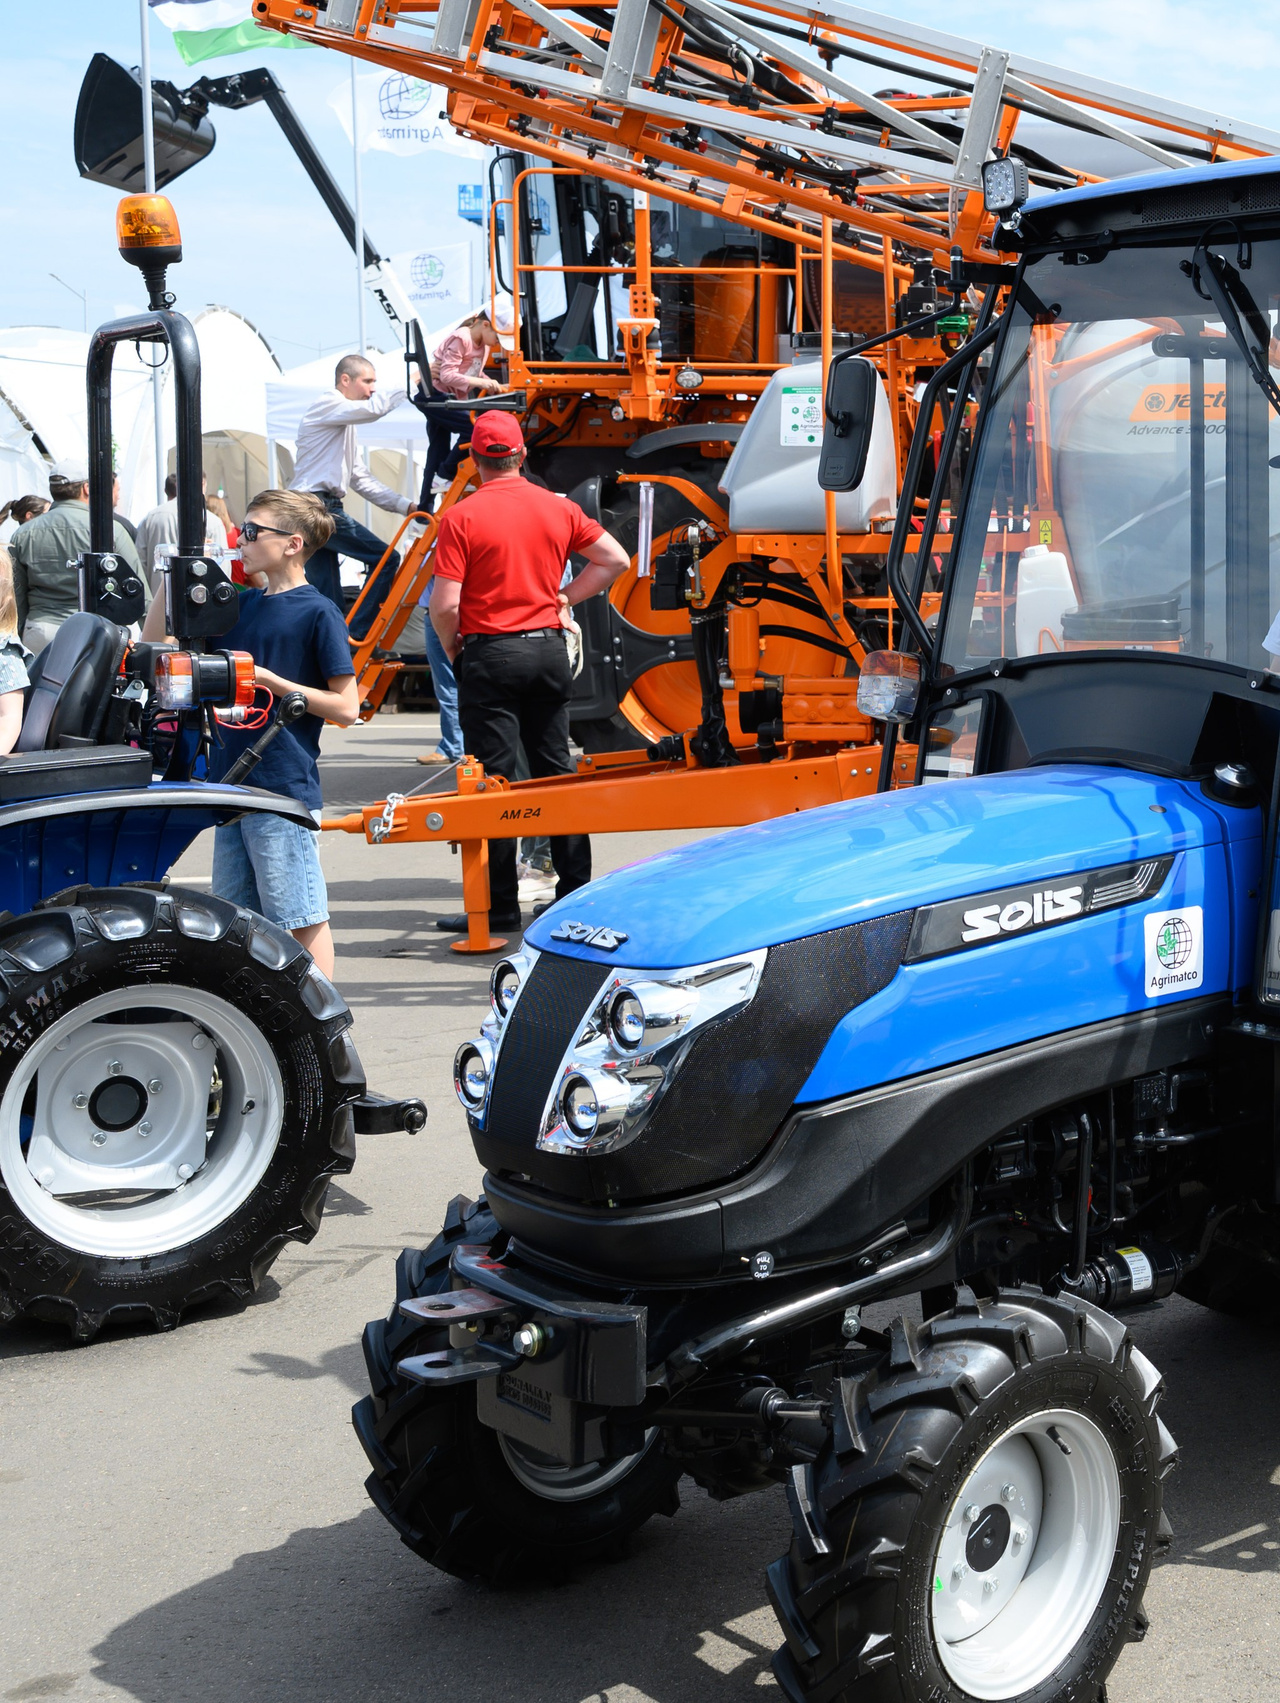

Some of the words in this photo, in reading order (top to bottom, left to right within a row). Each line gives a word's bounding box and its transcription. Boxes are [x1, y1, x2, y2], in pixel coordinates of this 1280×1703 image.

[1127, 424, 1184, 436] Advance
[500, 809, 521, 820] AM
[523, 807, 541, 819] 24
[1150, 969, 1198, 990] Agrimatco
[756, 1256, 771, 1265] PULL
